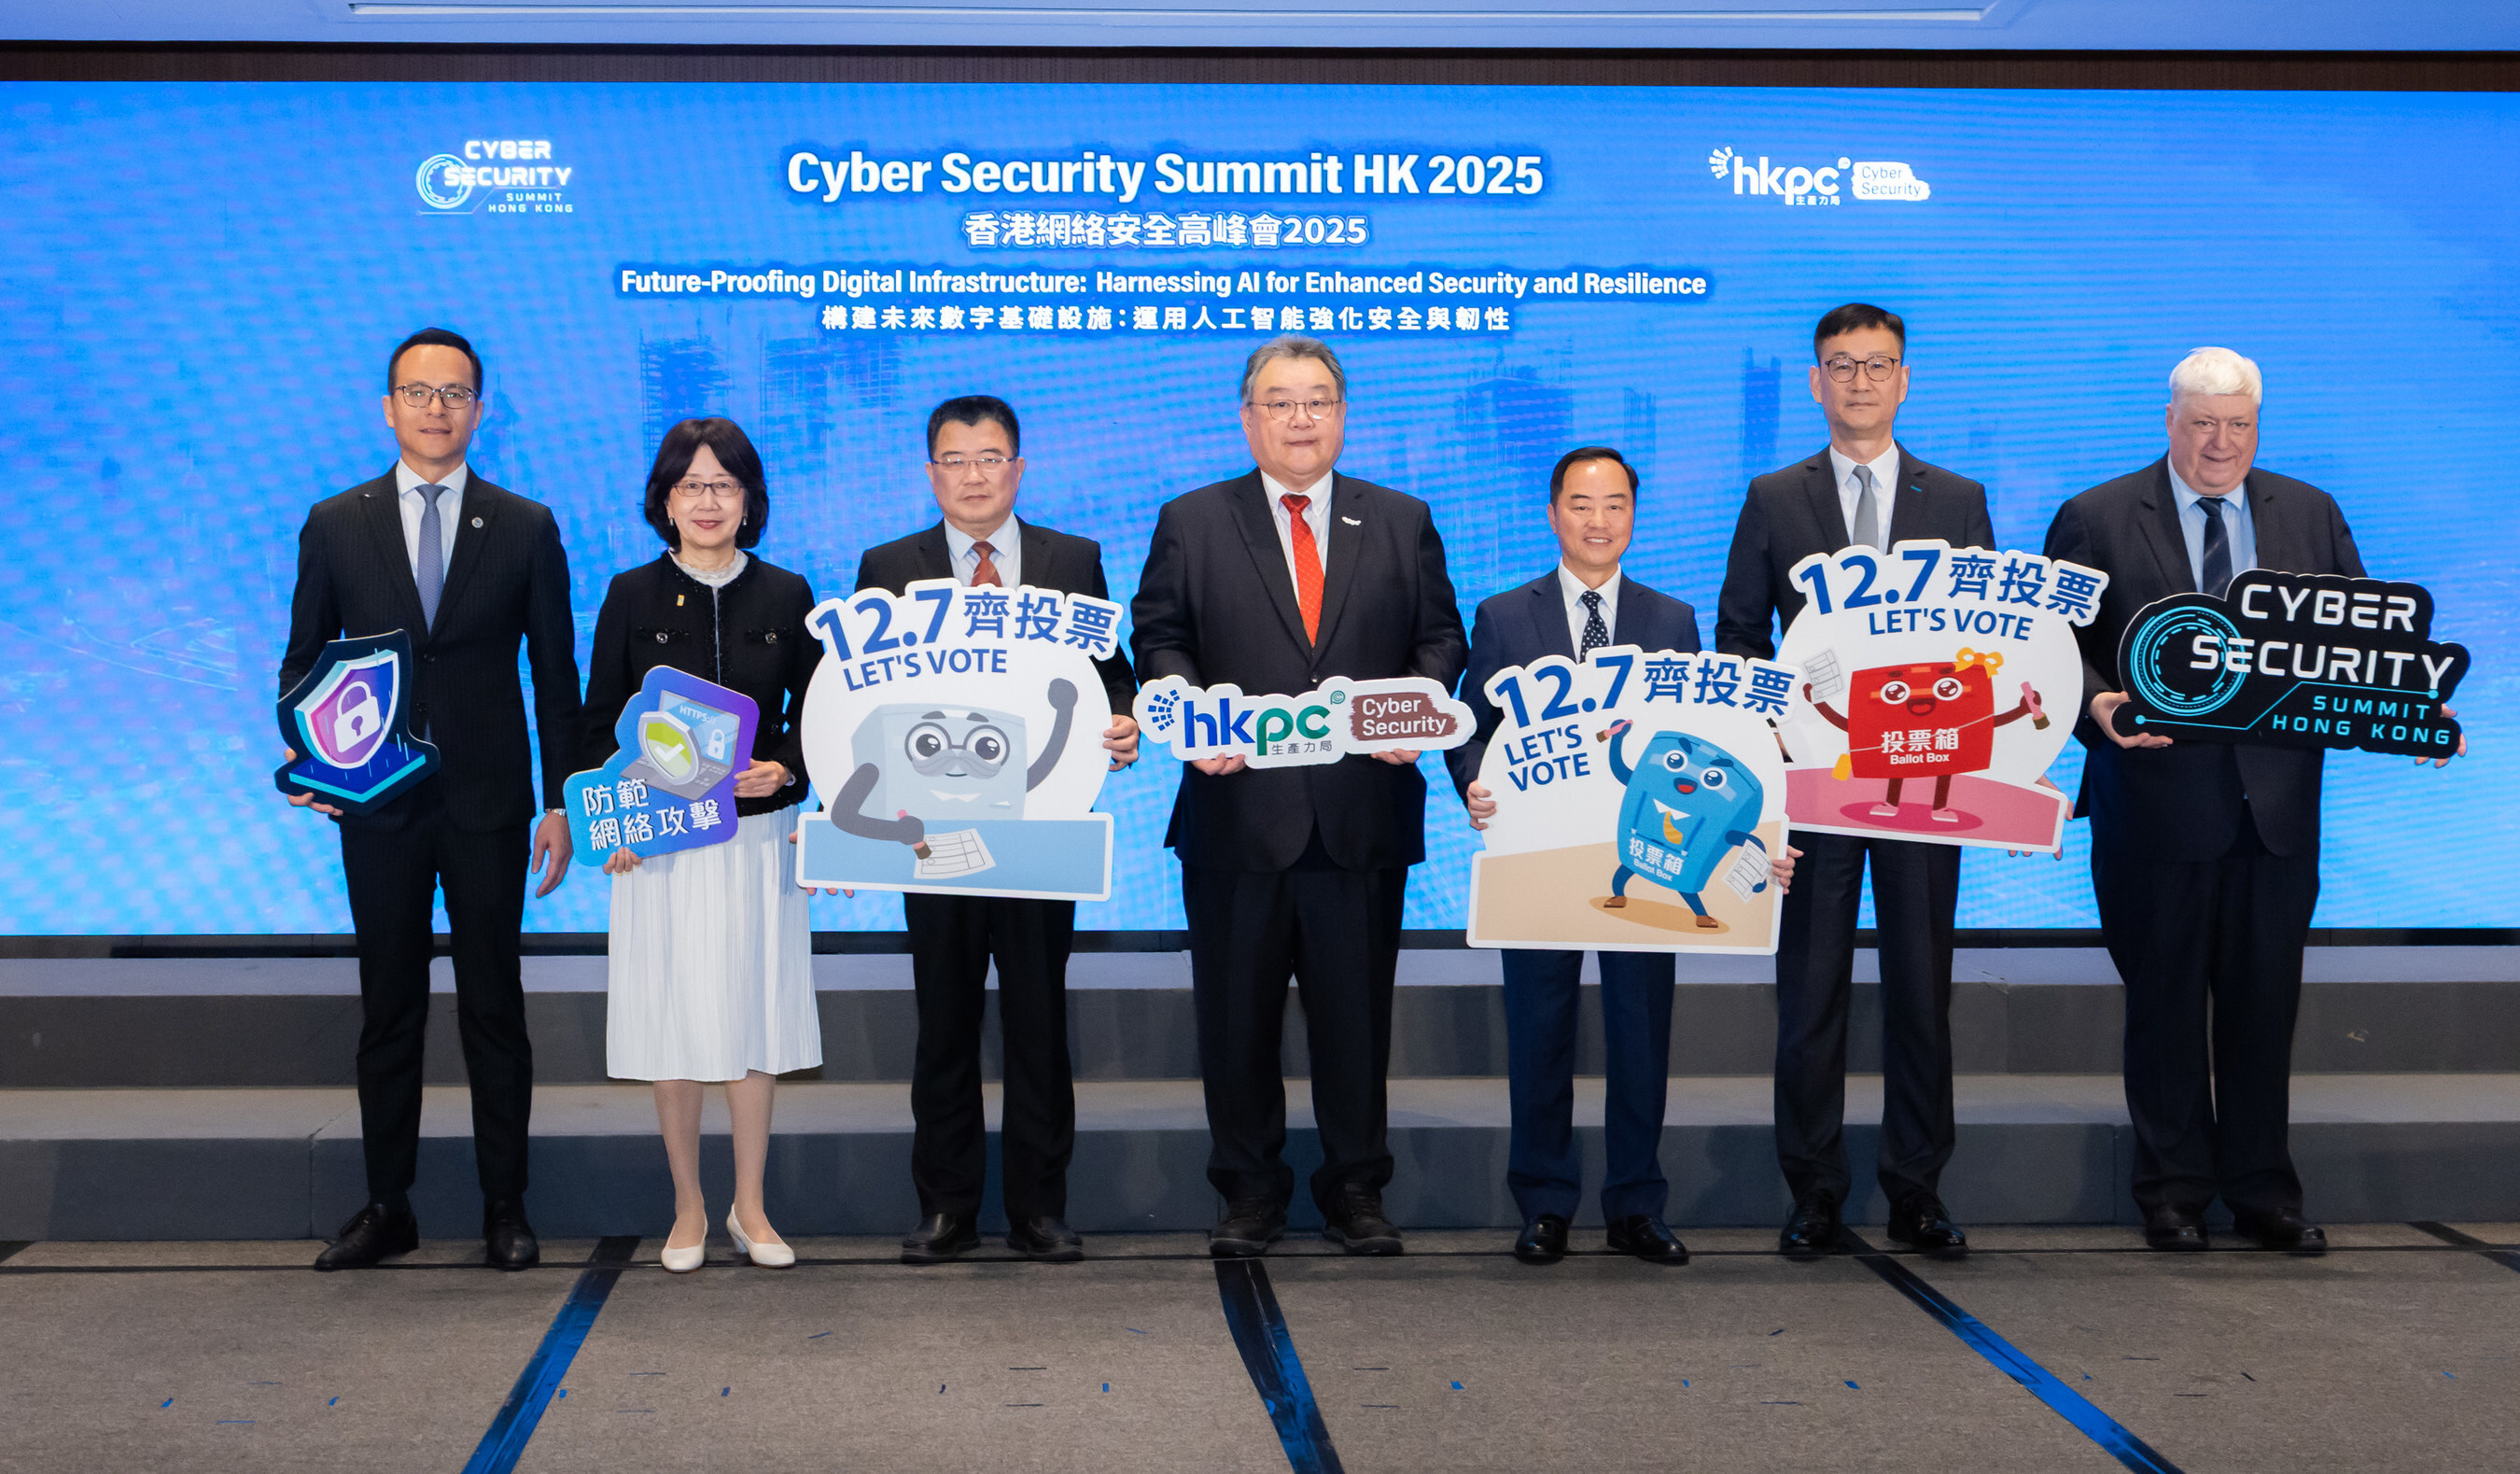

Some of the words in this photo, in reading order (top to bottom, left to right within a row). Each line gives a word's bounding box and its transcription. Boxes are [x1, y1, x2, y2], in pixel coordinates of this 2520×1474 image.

[465, 140, 552, 160] CYBER
[443, 166, 572, 187] SECURITY
[788, 151, 931, 202] Cyber
[941, 151, 1146, 202] Security
[1155, 151, 1343, 194] Summit
[1353, 155, 1421, 194] HK
[1428, 154, 1544, 195] 2025
[1733, 156, 1841, 205] hkpc
[1861, 165, 1902, 180] Cyber
[1861, 182, 1922, 196] Security
[488, 204, 526, 213] HONG
[535, 204, 574, 213] KONG
[506, 192, 563, 202] SUMMIT
[964, 212, 1368, 247] 香港網絡安全高峰會2025
[622, 269, 816, 299] Future-Proofing
[822, 269, 903, 299] Digital
[909, 270, 1087, 294] Infrastructure:
[1096, 271, 1231, 299] Harnessing
[1237, 271, 1260, 294] AI
[1266, 271, 1300, 295] for
[1305, 272, 1423, 295] Enhanced
[1428, 271, 1529, 299] Security
[1533, 272, 1579, 295] and
[1585, 272, 1707, 296] Resilience
[1799, 549, 1941, 615] 12.7
[1948, 555, 2102, 620] 齊投票
[2242, 583, 2416, 632] CYBER
[815, 588, 954, 662] 12.7
[963, 591, 1116, 653] 齊投票
[1869, 608, 1947, 636] LET'S
[1953, 610, 2034, 641] VOTE
[843, 652, 922, 692] LET'S
[926, 649, 1008, 675] VOTE
[2190, 635, 2455, 690] SECURITY
[1494, 654, 1634, 728] 12.7
[1644, 657, 1796, 717] 齊投票
[1362, 697, 1421, 721] Cyber
[2312, 695, 2430, 721] SUMMIT
[1183, 697, 1331, 756] hkpc
[1362, 714, 1448, 737] Security
[1881, 727, 1959, 753] 投票箱
[2273, 714, 2352, 736] HONG
[2371, 724, 2451, 745] KONG
[1271, 739, 1333, 756] 生產力局
[1504, 723, 1583, 766] LET'S
[1890, 753, 1925, 765] Ballot
[1925, 751, 1950, 763] Box
[1507, 752, 1590, 792] VOTE
[581, 779, 650, 818] 防範
[588, 798, 722, 851] 網絡攻擊
[1629, 837, 1685, 876] 投票箱
[1633, 857, 1656, 875] Ballot
[1656, 868, 1673, 881] Box
